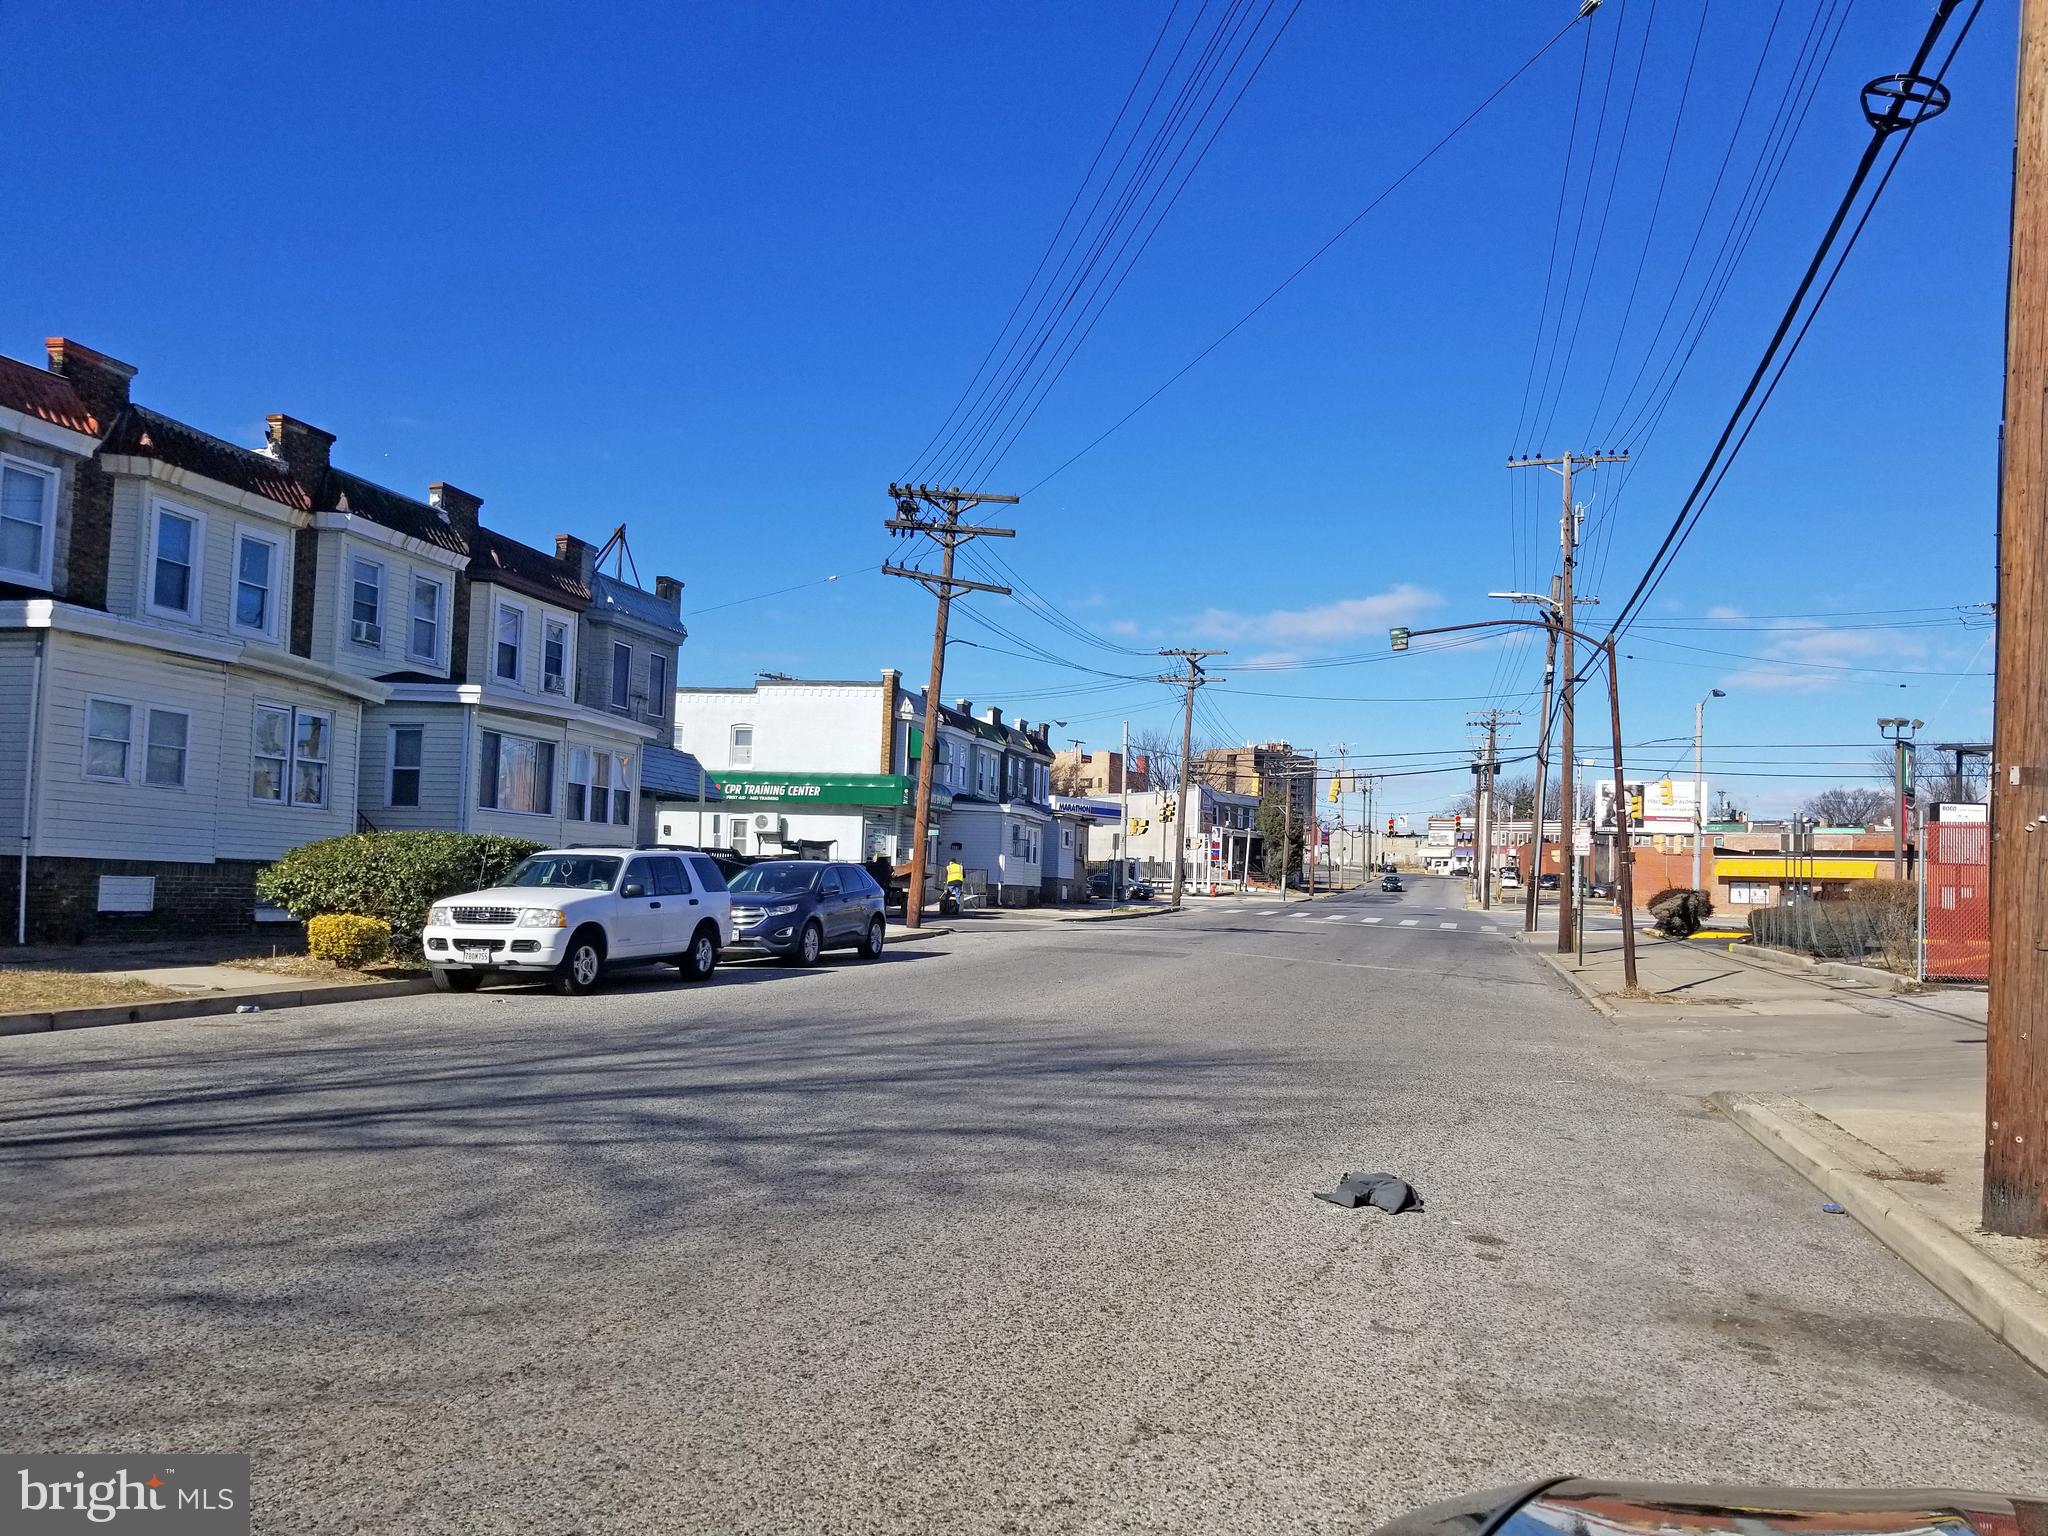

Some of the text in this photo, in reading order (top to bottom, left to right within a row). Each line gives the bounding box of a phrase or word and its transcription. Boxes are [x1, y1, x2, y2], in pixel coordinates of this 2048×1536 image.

[725, 784, 820, 796] CPR TRAINING CENTER
[1059, 802, 1091, 814] MARATHON
